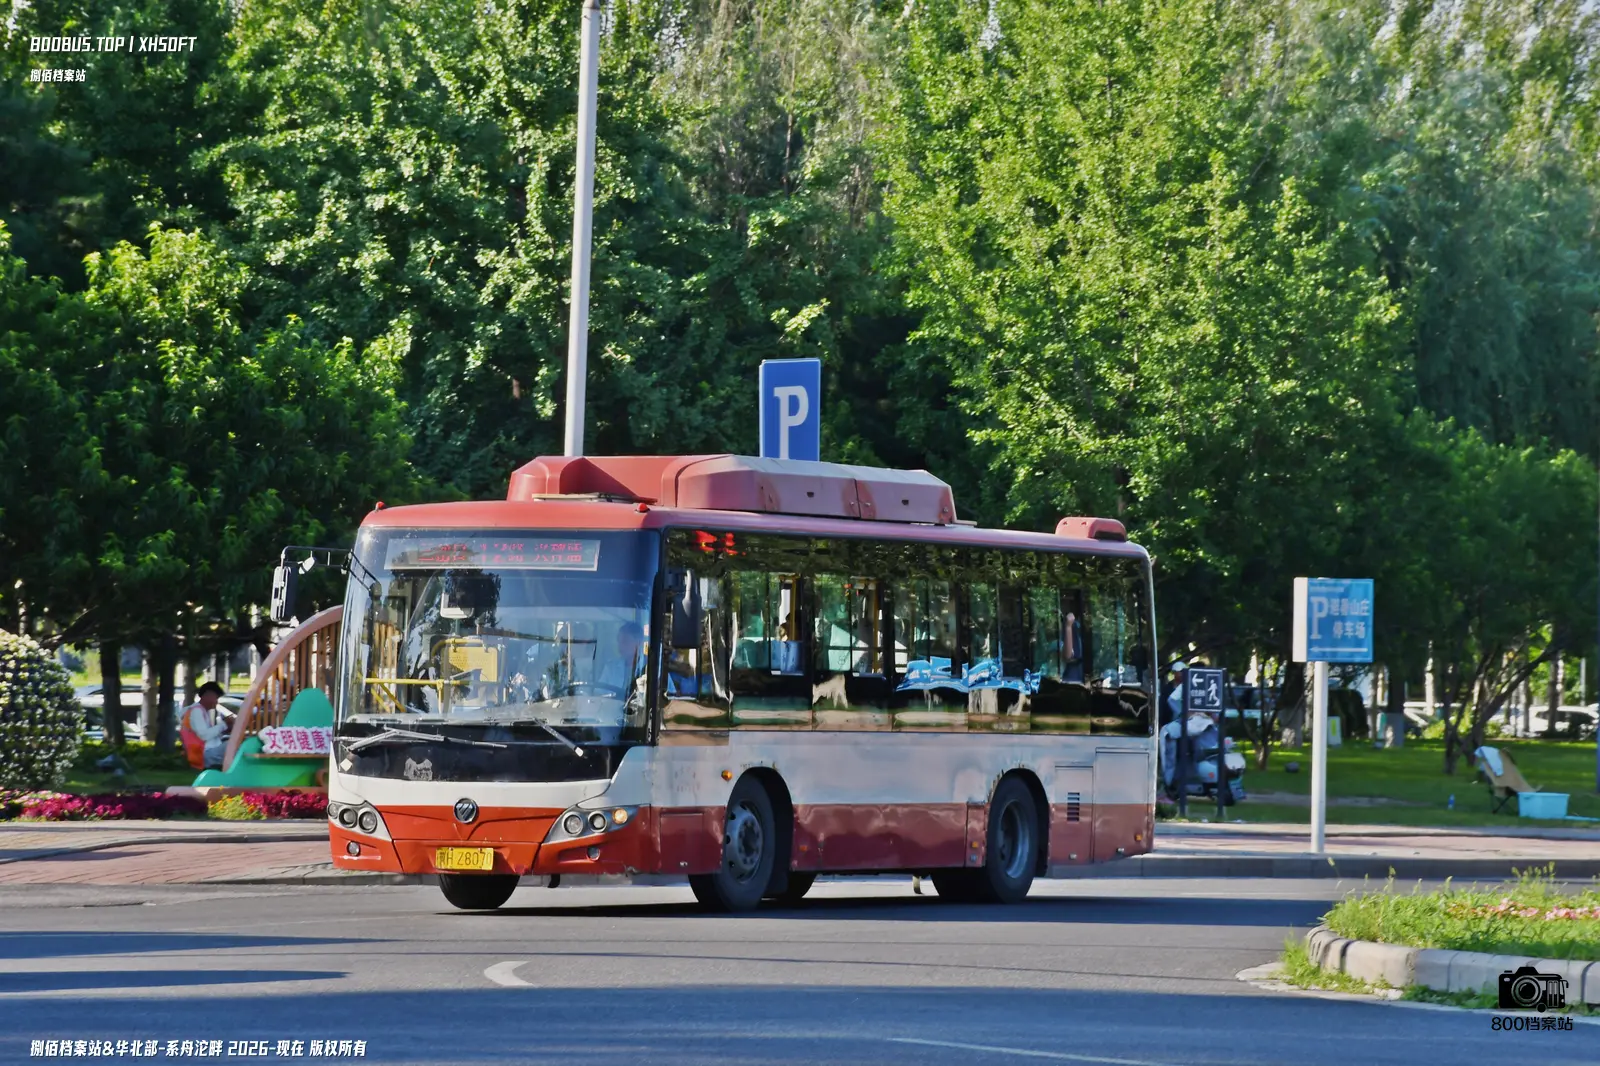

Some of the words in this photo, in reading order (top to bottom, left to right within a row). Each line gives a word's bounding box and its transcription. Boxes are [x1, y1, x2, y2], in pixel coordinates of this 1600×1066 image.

[773, 385, 809, 460] P
[1309, 596, 1329, 640] P
[1333, 621, 1366, 639] 停车场
